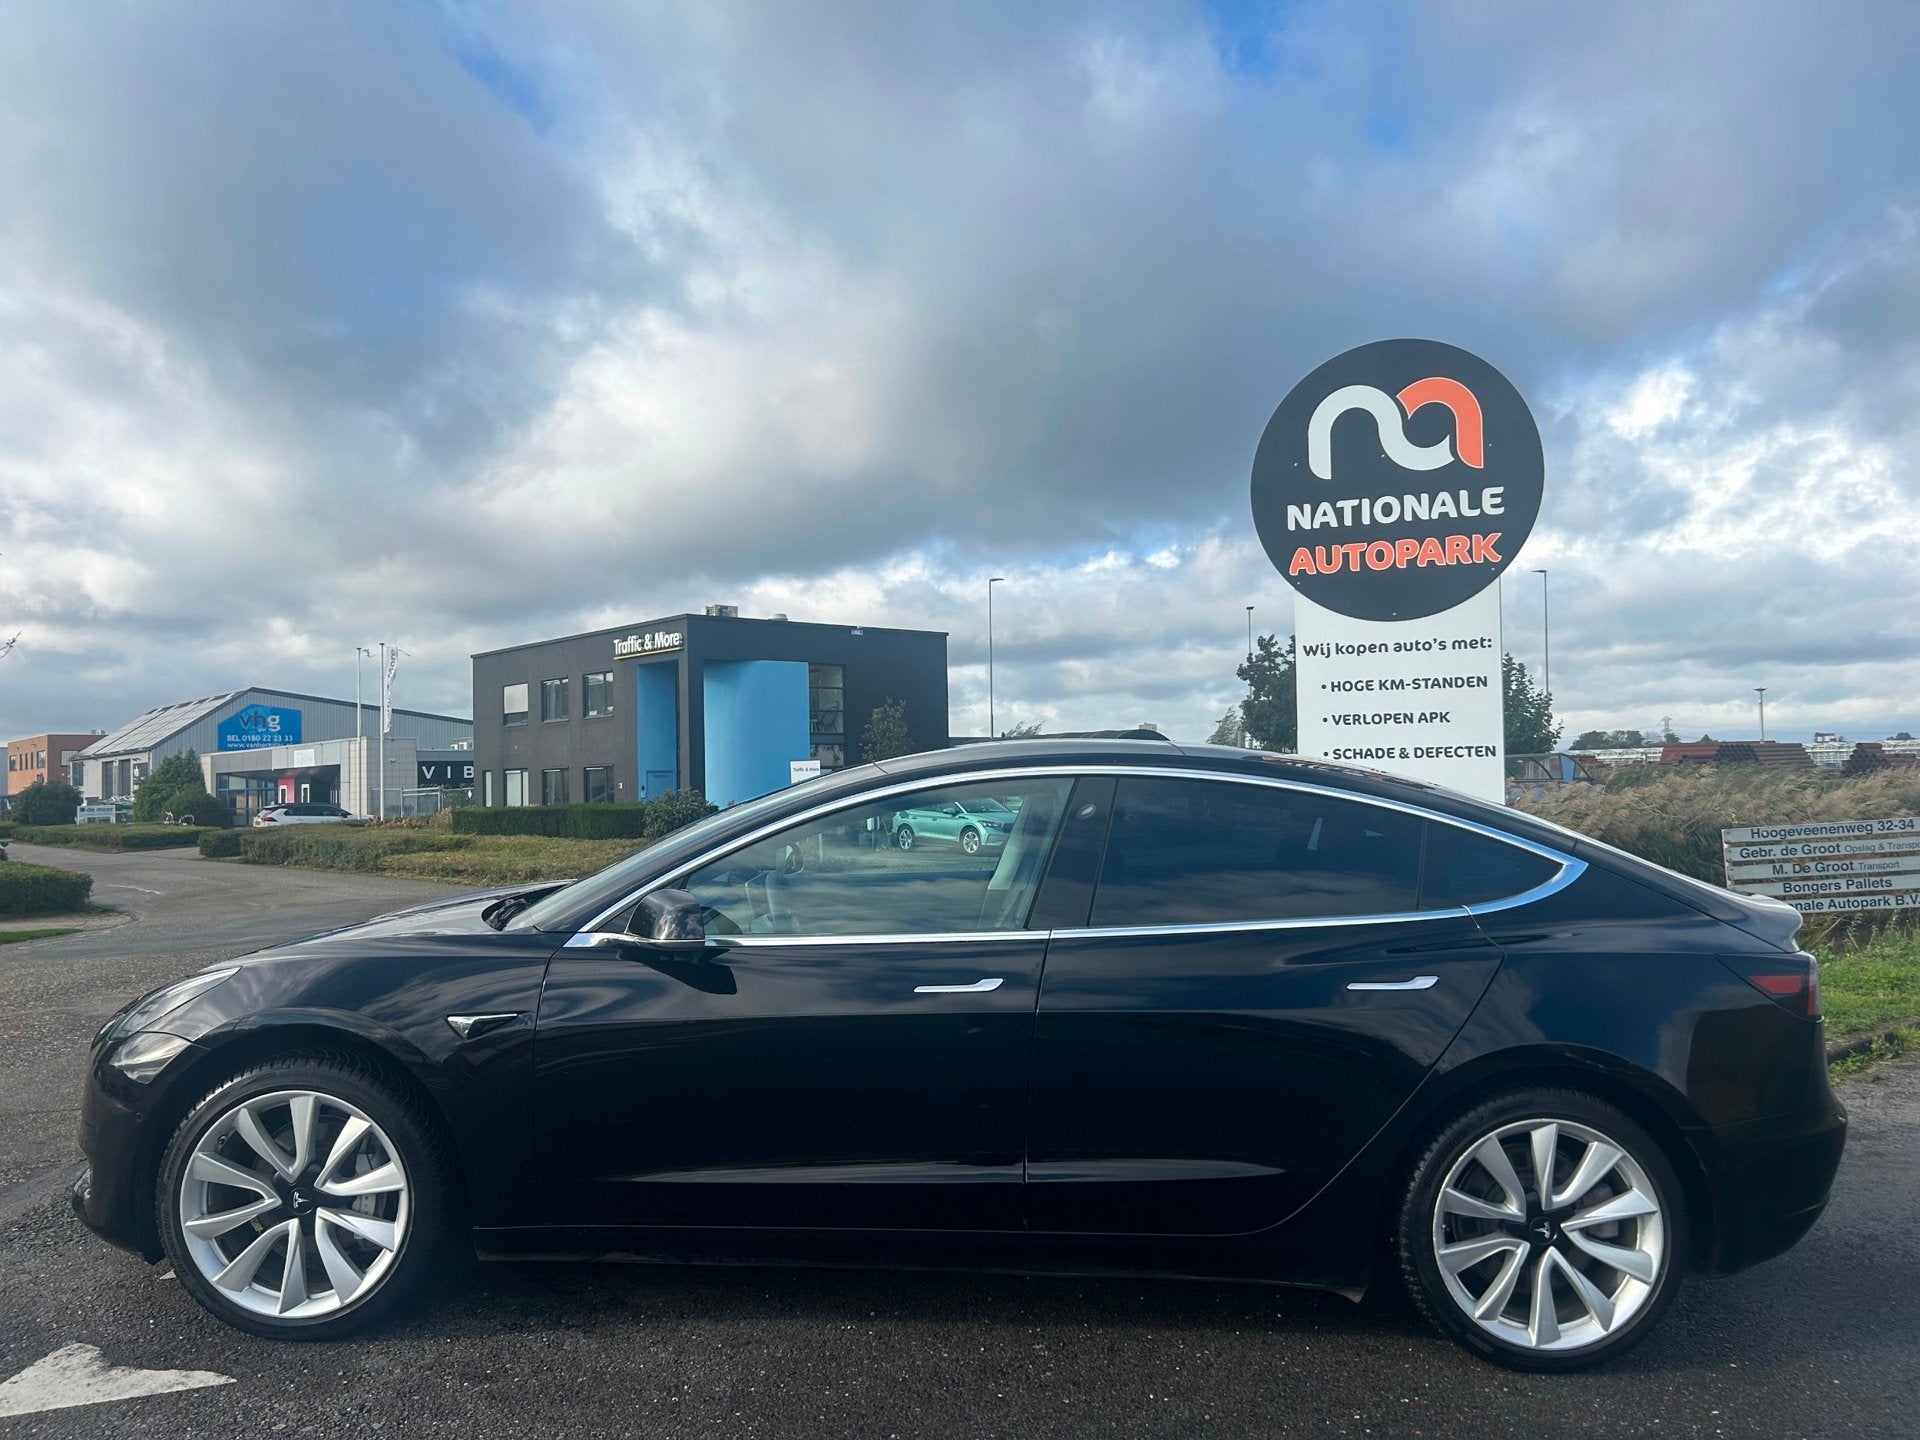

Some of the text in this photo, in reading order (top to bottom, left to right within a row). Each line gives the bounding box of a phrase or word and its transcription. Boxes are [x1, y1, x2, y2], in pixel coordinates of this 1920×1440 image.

[1286, 486, 1504, 531] NATIONALE
[1289, 533, 1502, 576] AUTOPARK
[613, 631, 682, 655] Traffic & More
[1302, 643, 1331, 658] Wij
[1335, 641, 1389, 657] kopen
[1452, 636, 1492, 651] met:
[1331, 675, 1488, 692] HOGE KM-STANDEN
[240, 710, 281, 732] vhg
[1331, 711, 1451, 726] VERLOPEN APK
[227, 734, 293, 742] BEL 0180 22 23 33
[1332, 745, 1497, 760] SCHADE & DEFECTEN
[422, 765, 474, 779] VIB
[1750, 818, 1915, 840] Hoogeveenenweg 32-34
[1739, 847, 1776, 859] Gebr.
[1780, 845, 1797, 857] de
[1801, 843, 1842, 856] Groot
[1844, 844, 1876, 854] Opslag
[1878, 843, 1884, 851] &
[1772, 861, 1900, 876] M. De Groot Transport
[1783, 878, 1893, 894] Bongers Pallets
[1828, 895, 1891, 910] Autopark
